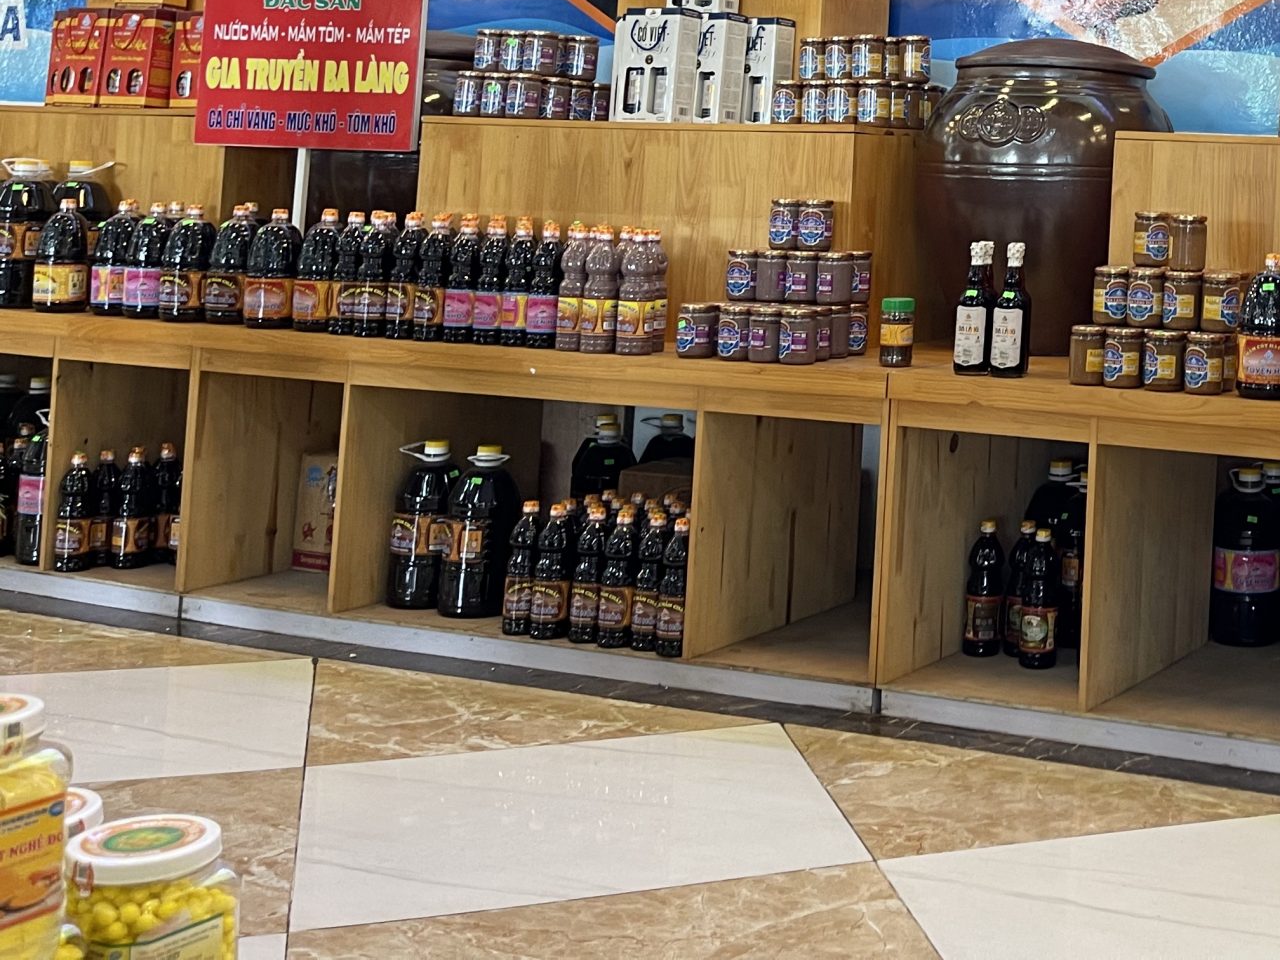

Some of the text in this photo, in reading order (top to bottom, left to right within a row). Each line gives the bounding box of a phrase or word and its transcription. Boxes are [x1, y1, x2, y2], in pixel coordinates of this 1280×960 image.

[214, 19, 249, 41] NƯỚC
[251, 17, 279, 41] MẮM
[288, 18, 316, 43] MẮM
[317, 22, 345, 43] TÔM
[355, 19, 384, 44] MẮM
[386, 23, 411, 45] TÉP
[205, 56, 241, 90] GIA
[323, 59, 350, 92] BA
[354, 53, 410, 95] LÀNG
